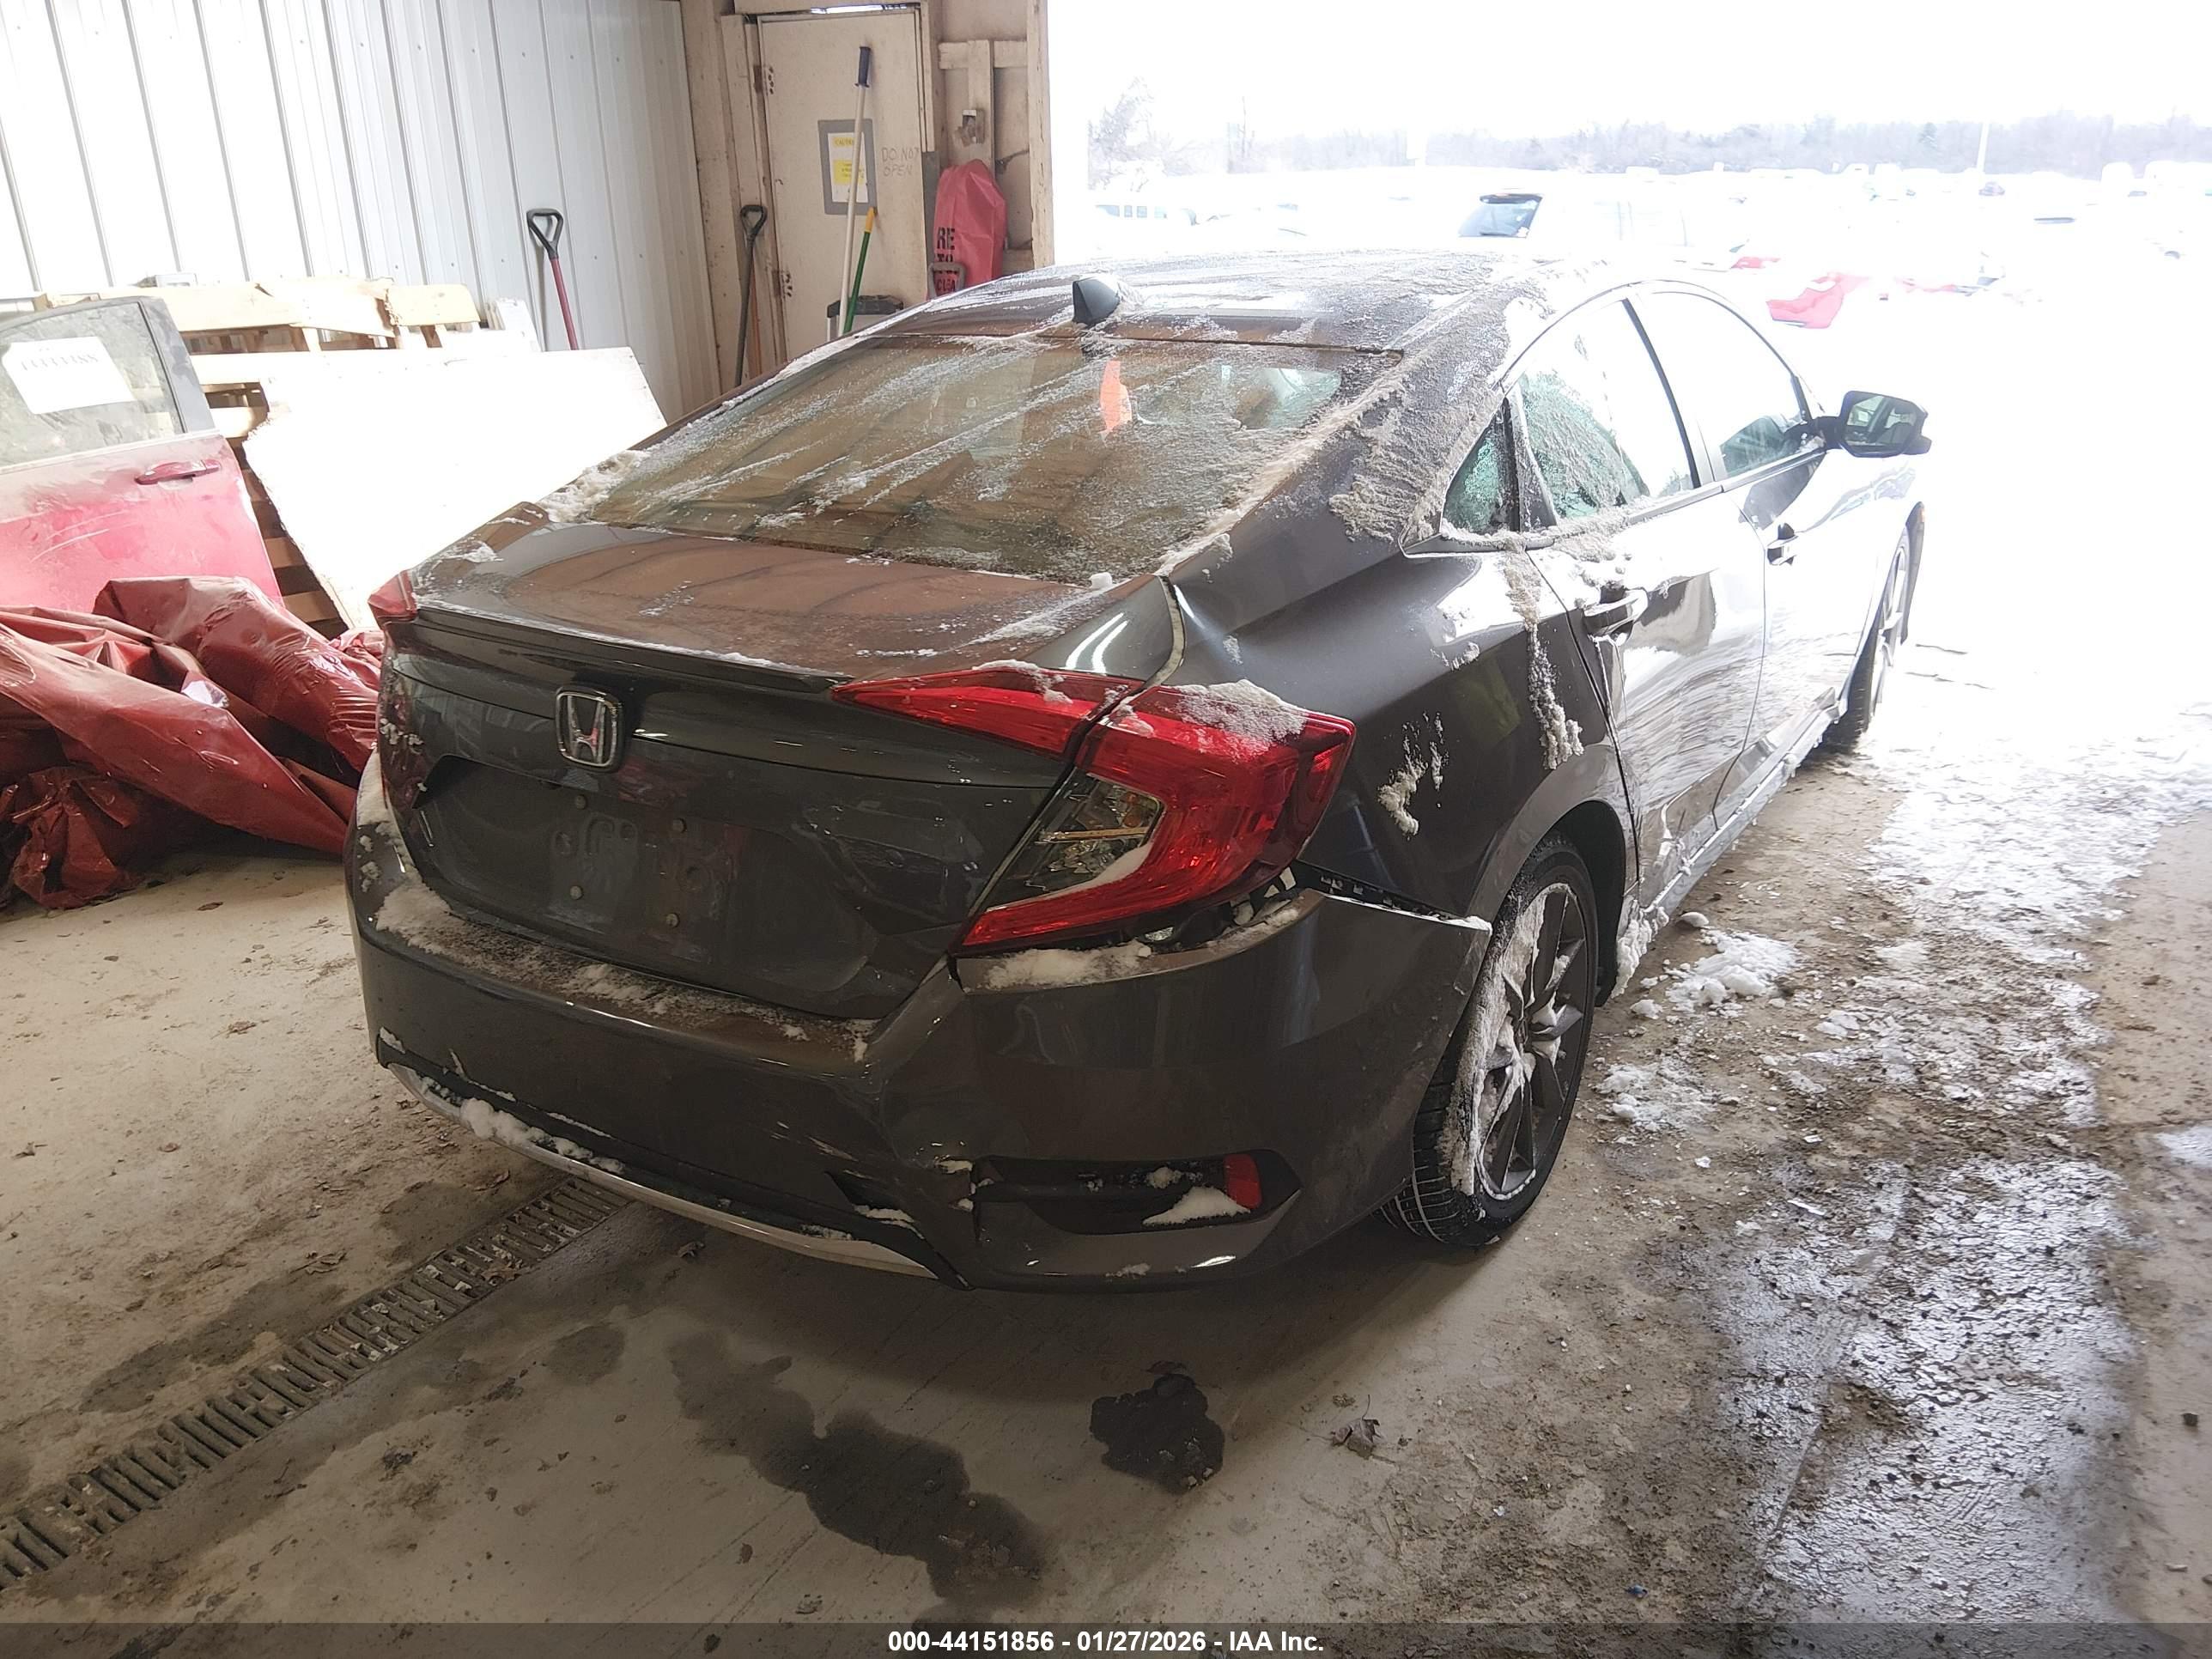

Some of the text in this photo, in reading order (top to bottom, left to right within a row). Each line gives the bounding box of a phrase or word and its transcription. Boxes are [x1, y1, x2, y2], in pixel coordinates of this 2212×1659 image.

[881, 146, 921, 162] DO NOT
[883, 163, 913, 177] OPEN
